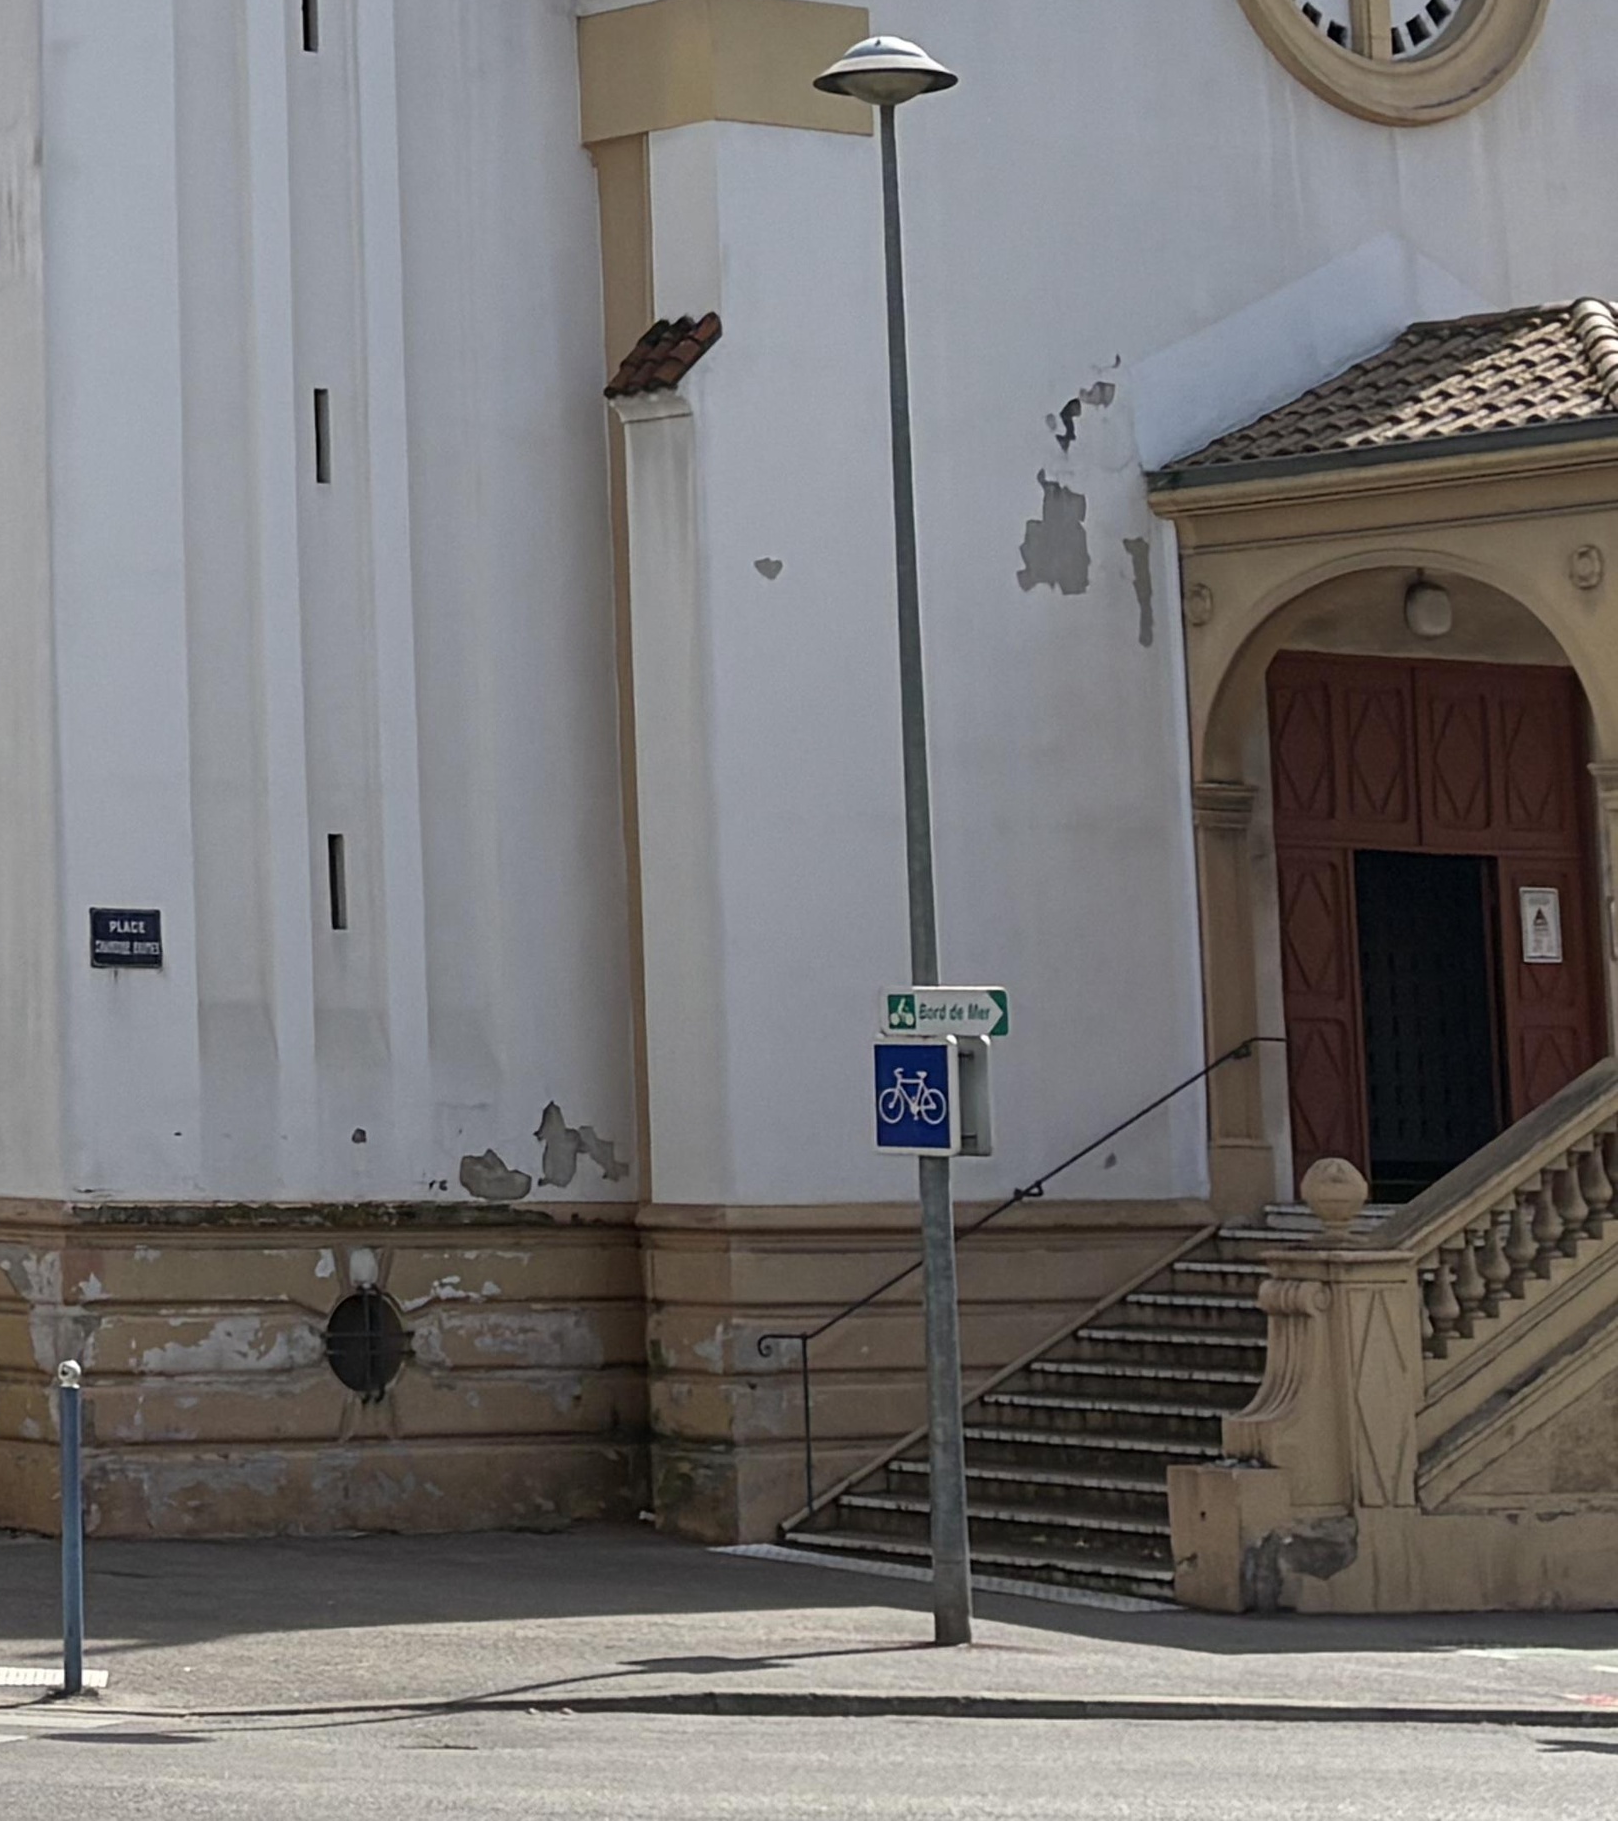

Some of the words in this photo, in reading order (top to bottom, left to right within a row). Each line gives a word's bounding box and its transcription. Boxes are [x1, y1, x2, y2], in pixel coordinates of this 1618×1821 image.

[109, 920, 146, 934] PLACE
[918, 1002, 946, 1020] Bord
[949, 1003, 964, 1020] de
[967, 1002, 991, 1020] Mer
